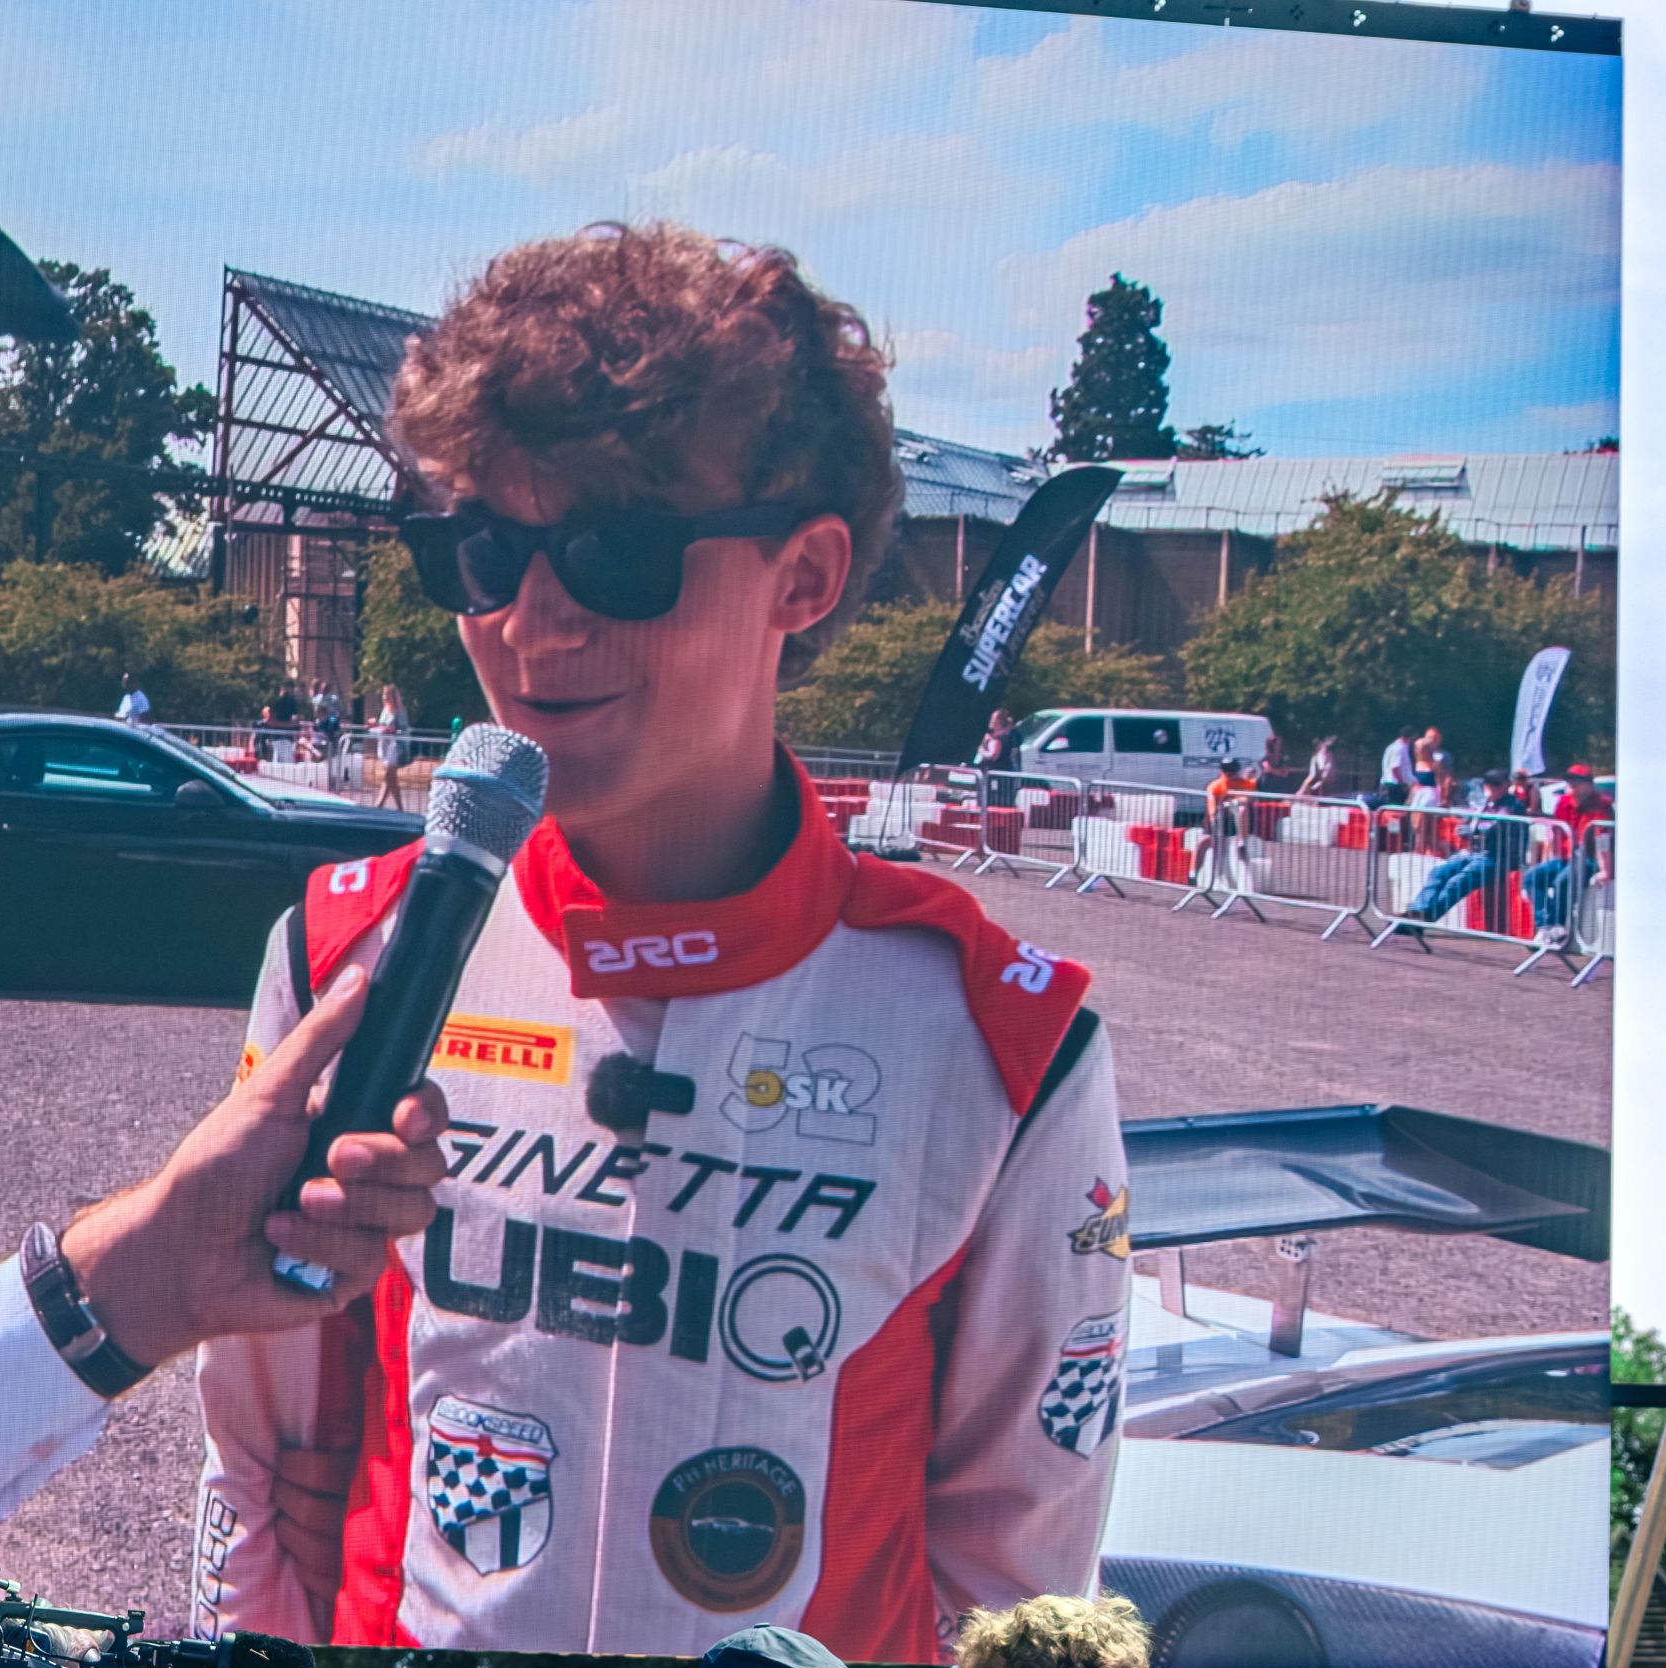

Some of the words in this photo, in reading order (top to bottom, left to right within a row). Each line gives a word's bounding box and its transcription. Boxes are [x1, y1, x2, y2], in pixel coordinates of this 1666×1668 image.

[961, 554, 1048, 692] SUPERCAR
[434, 1039, 554, 1070] IRELLI
[439, 1119, 877, 1240] GINETTA
[423, 1205, 842, 1383] UBIQ
[703, 1452, 797, 1497] HERITAGE
